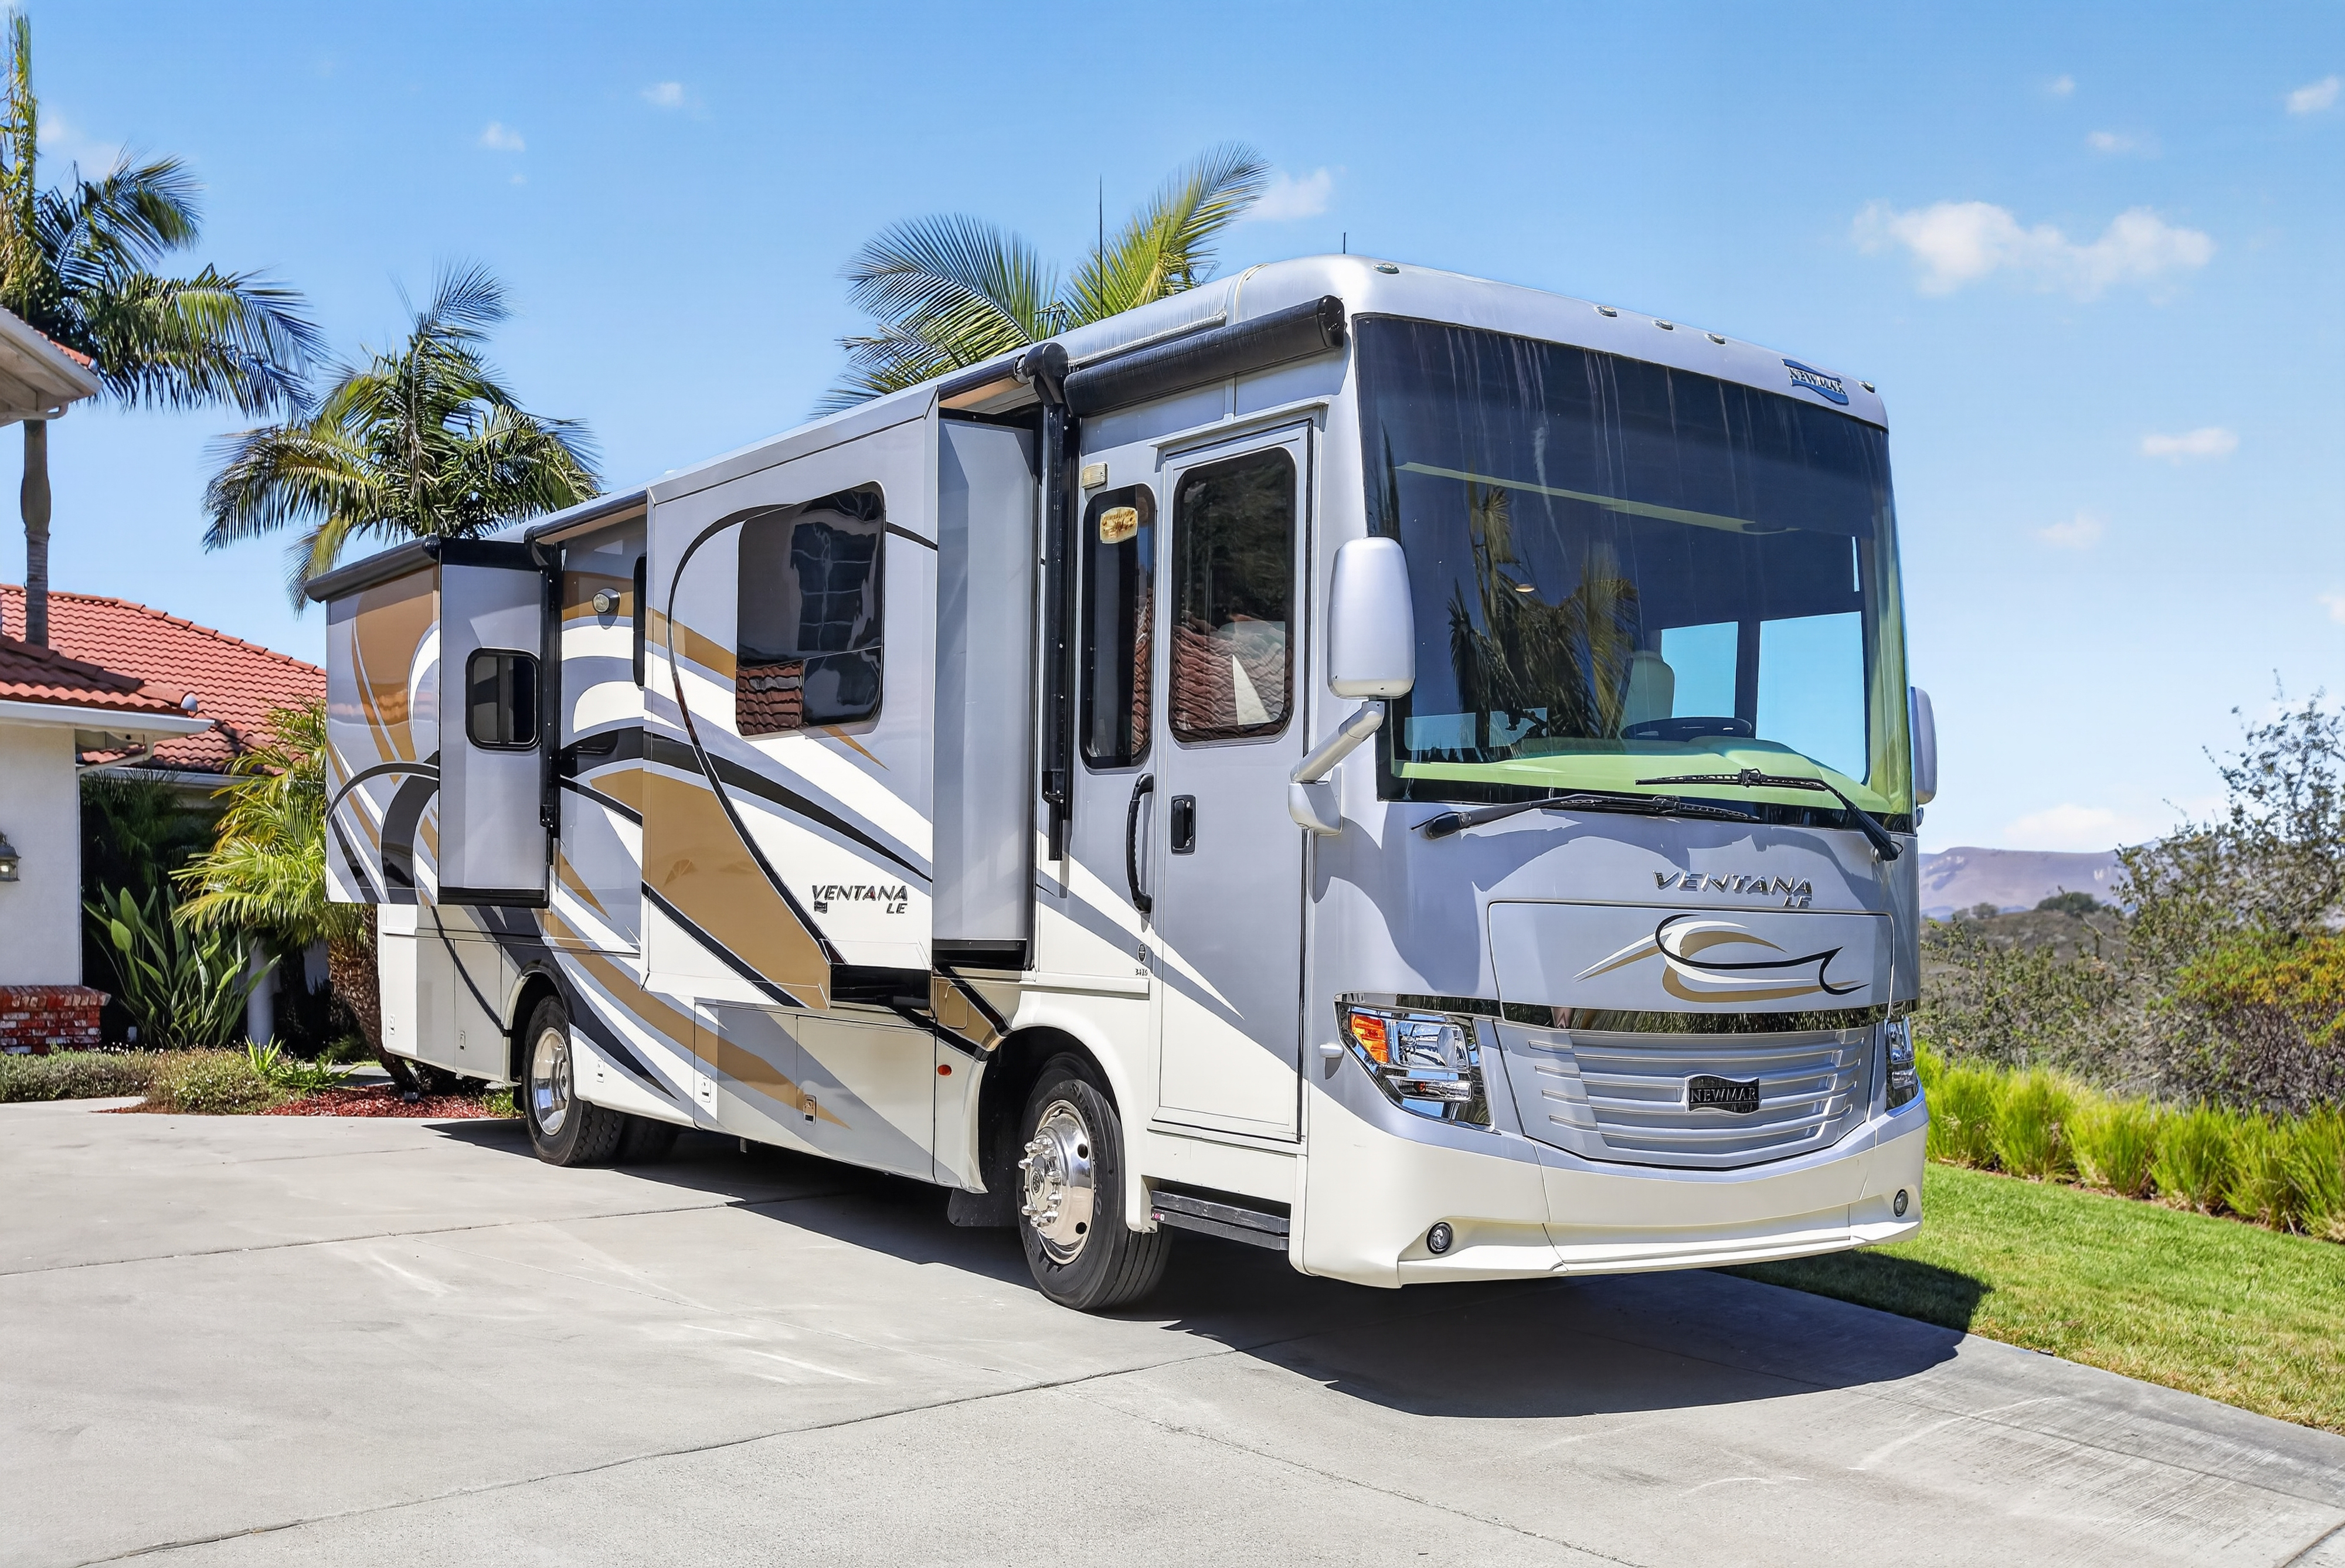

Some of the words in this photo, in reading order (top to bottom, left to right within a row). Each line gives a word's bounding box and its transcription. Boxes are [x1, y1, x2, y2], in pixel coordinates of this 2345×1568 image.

[1652, 869, 1813, 900] VENTANA
[812, 885, 908, 901] VENTANA
[886, 903, 908, 914] LE
[1690, 1087, 1756, 1103] NEWMAR
